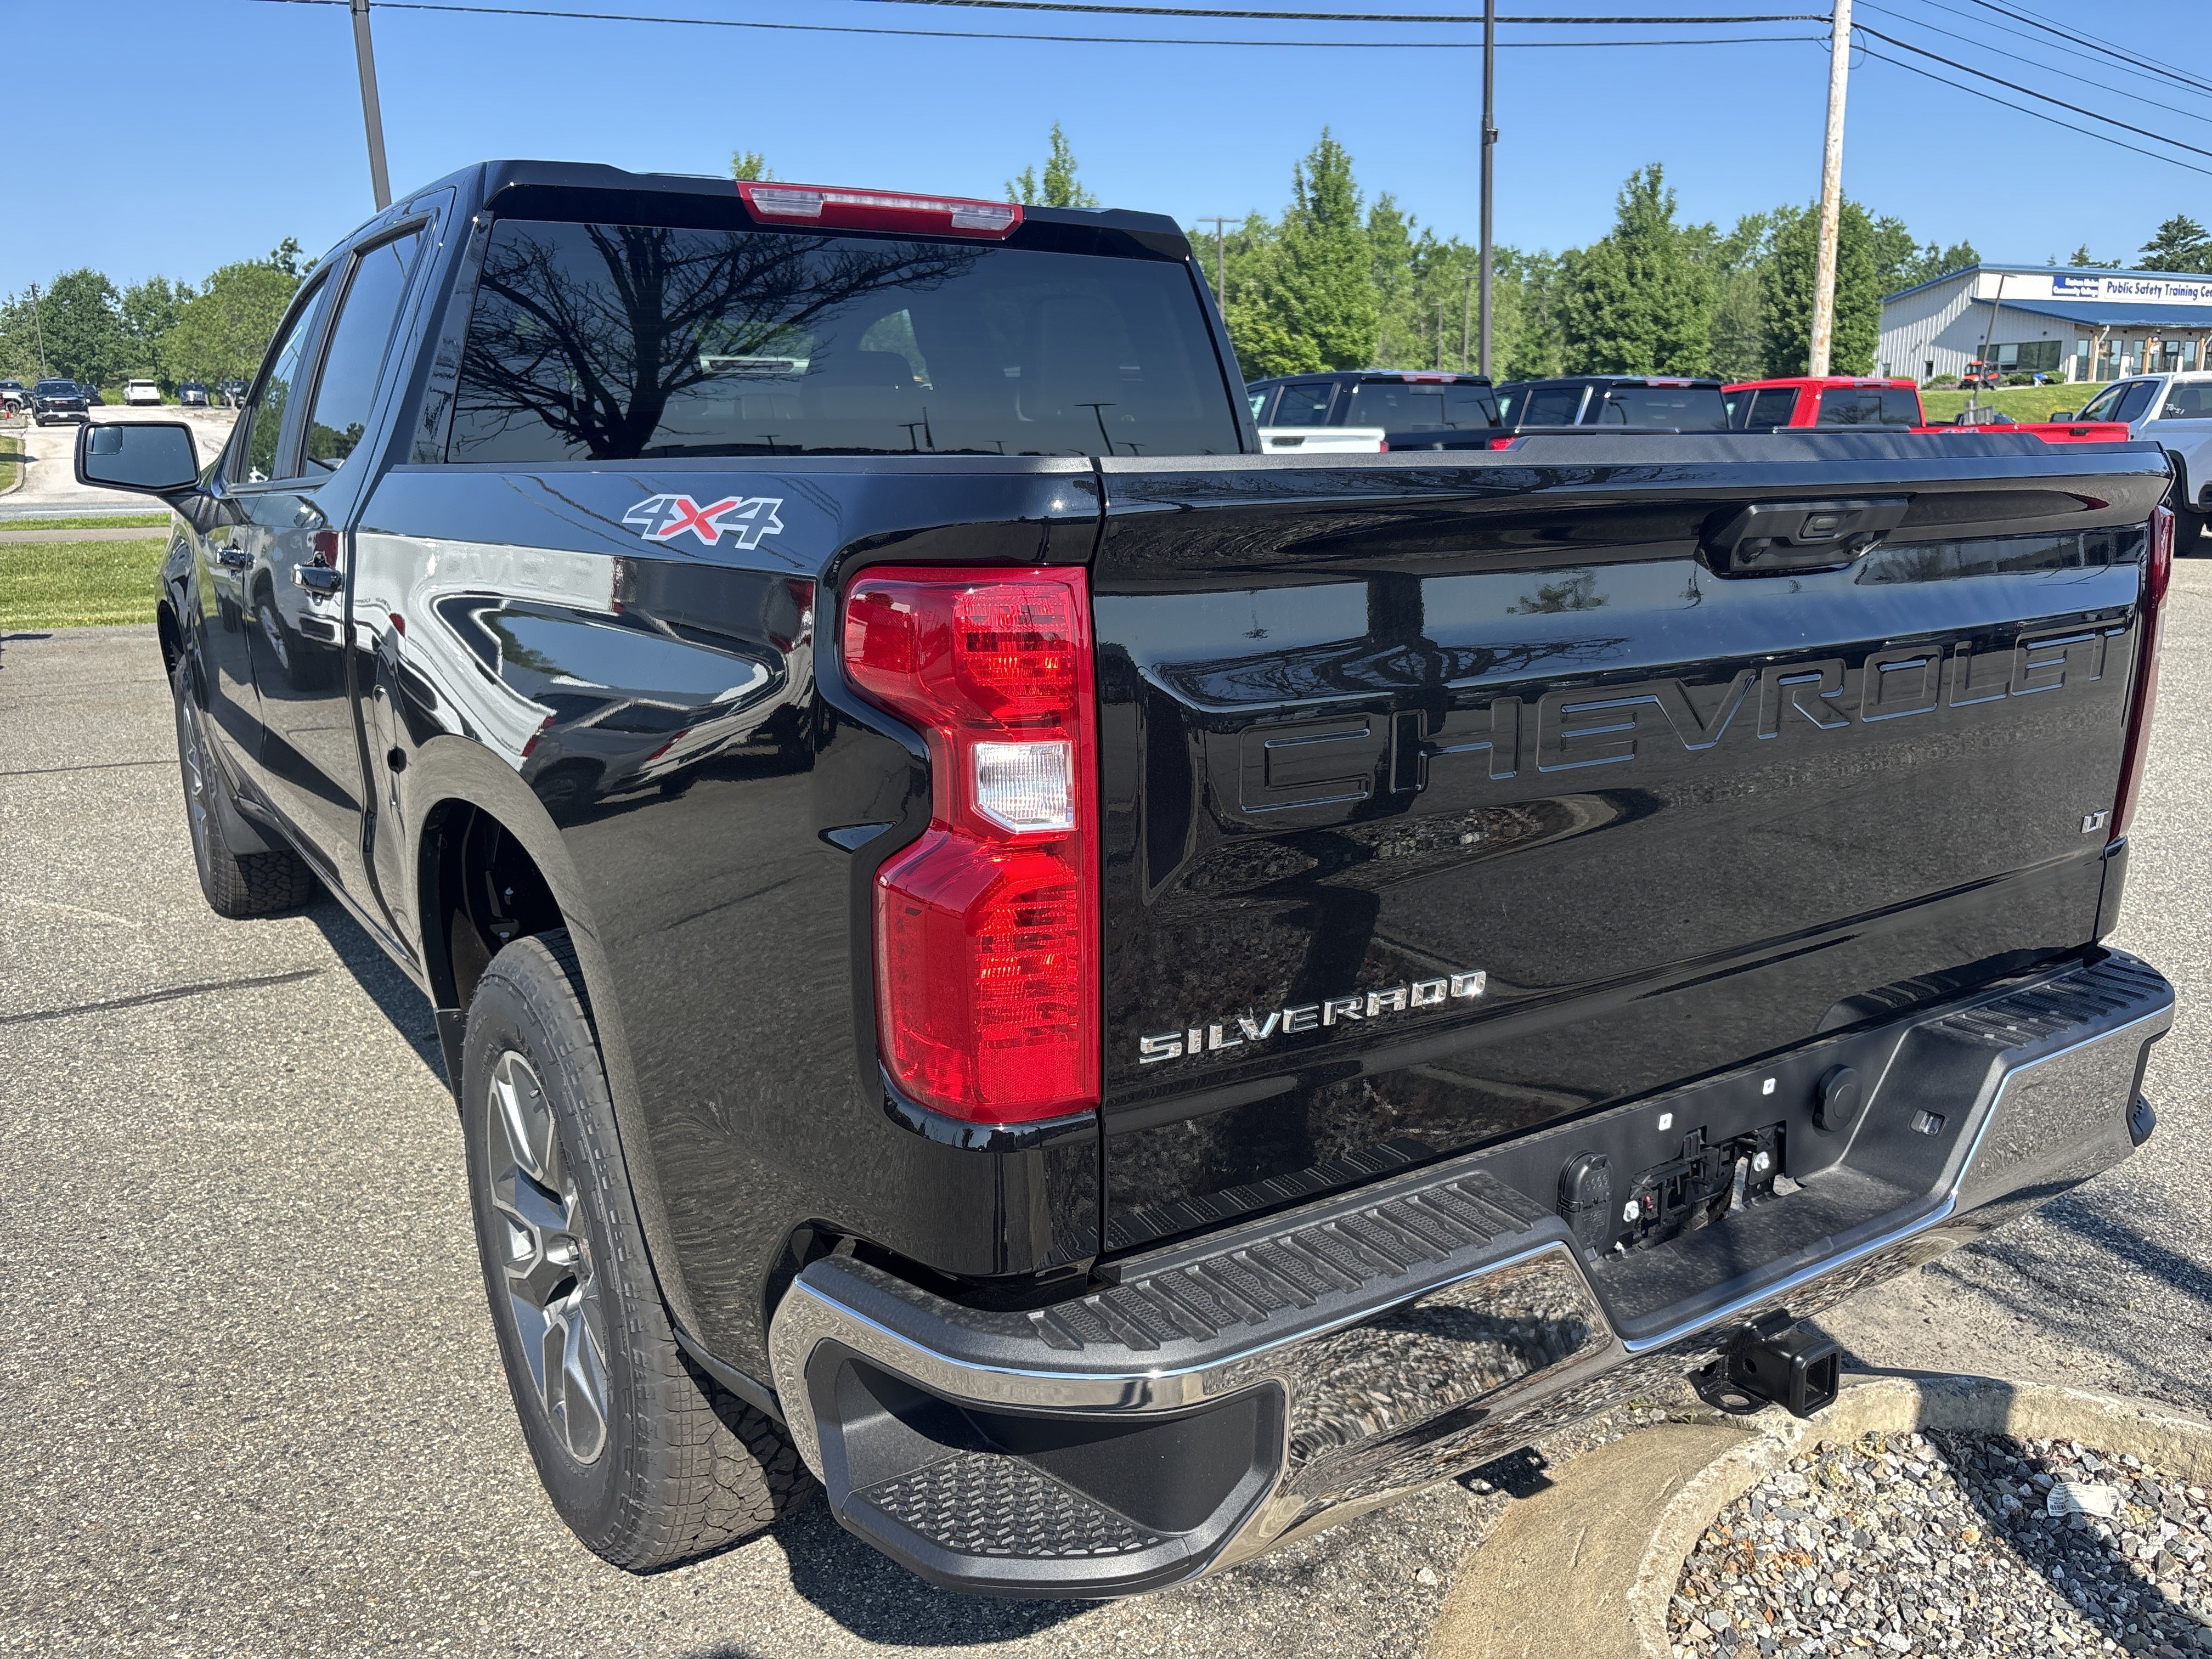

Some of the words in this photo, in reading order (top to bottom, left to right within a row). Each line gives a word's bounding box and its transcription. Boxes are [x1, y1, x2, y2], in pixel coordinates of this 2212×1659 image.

[2107, 280, 2133, 294] Public
[2135, 282, 2162, 299] Safety
[2165, 284, 2198, 301] Training
[1238, 617, 2126, 814] CHEVROLET
[2080, 809, 2109, 834] LT
[1139, 968, 1487, 1064] SILVERADO
